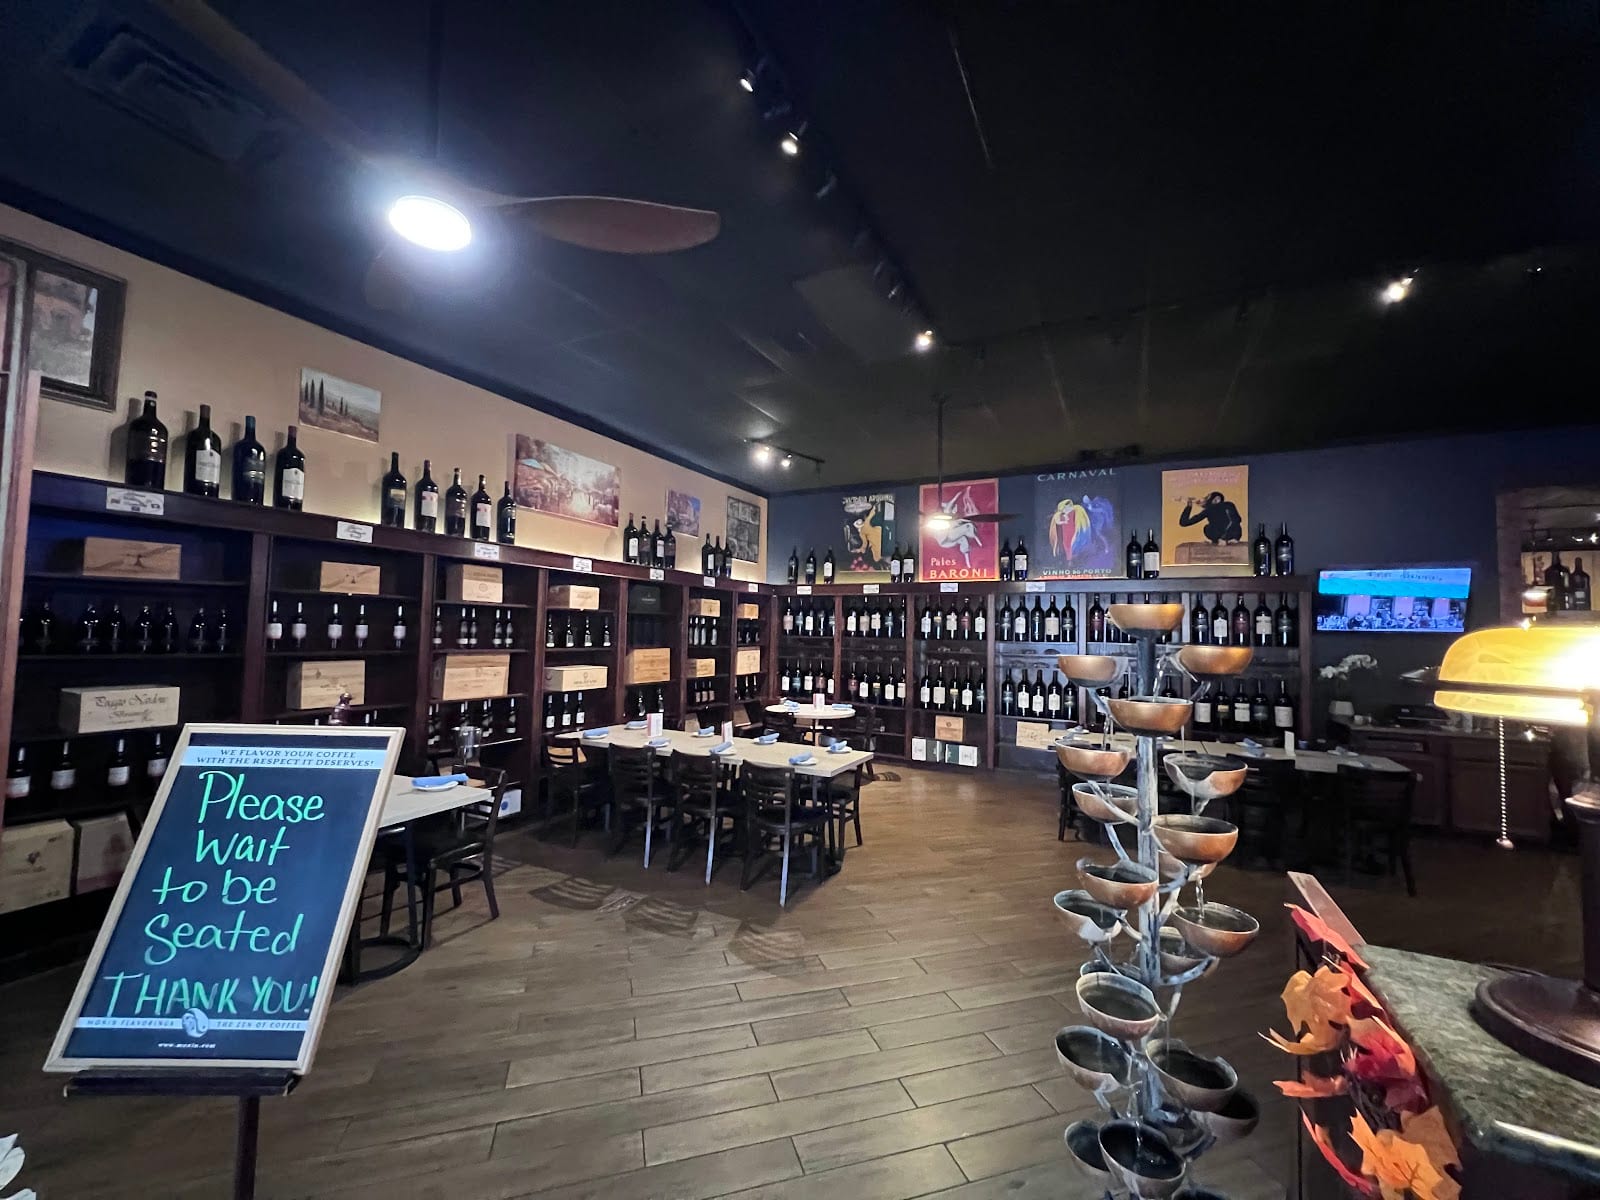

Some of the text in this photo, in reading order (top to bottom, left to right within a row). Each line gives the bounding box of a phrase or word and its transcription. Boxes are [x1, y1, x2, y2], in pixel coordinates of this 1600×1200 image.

[1037, 468, 1116, 481] CARNAVAL
[930, 568, 987, 579] BARONI
[239, 749, 282, 757] FLAVOR
[284, 750, 314, 758] YOUR
[197, 756, 226, 764] WITH
[315, 759, 375, 767] DESERVES!
[198, 770, 326, 823] Please
[152, 867, 278, 904] to be
[144, 910, 304, 965] Seated
[103, 972, 318, 1017] THANK YOU!
[269, 1021, 302, 1029] COFFEE
